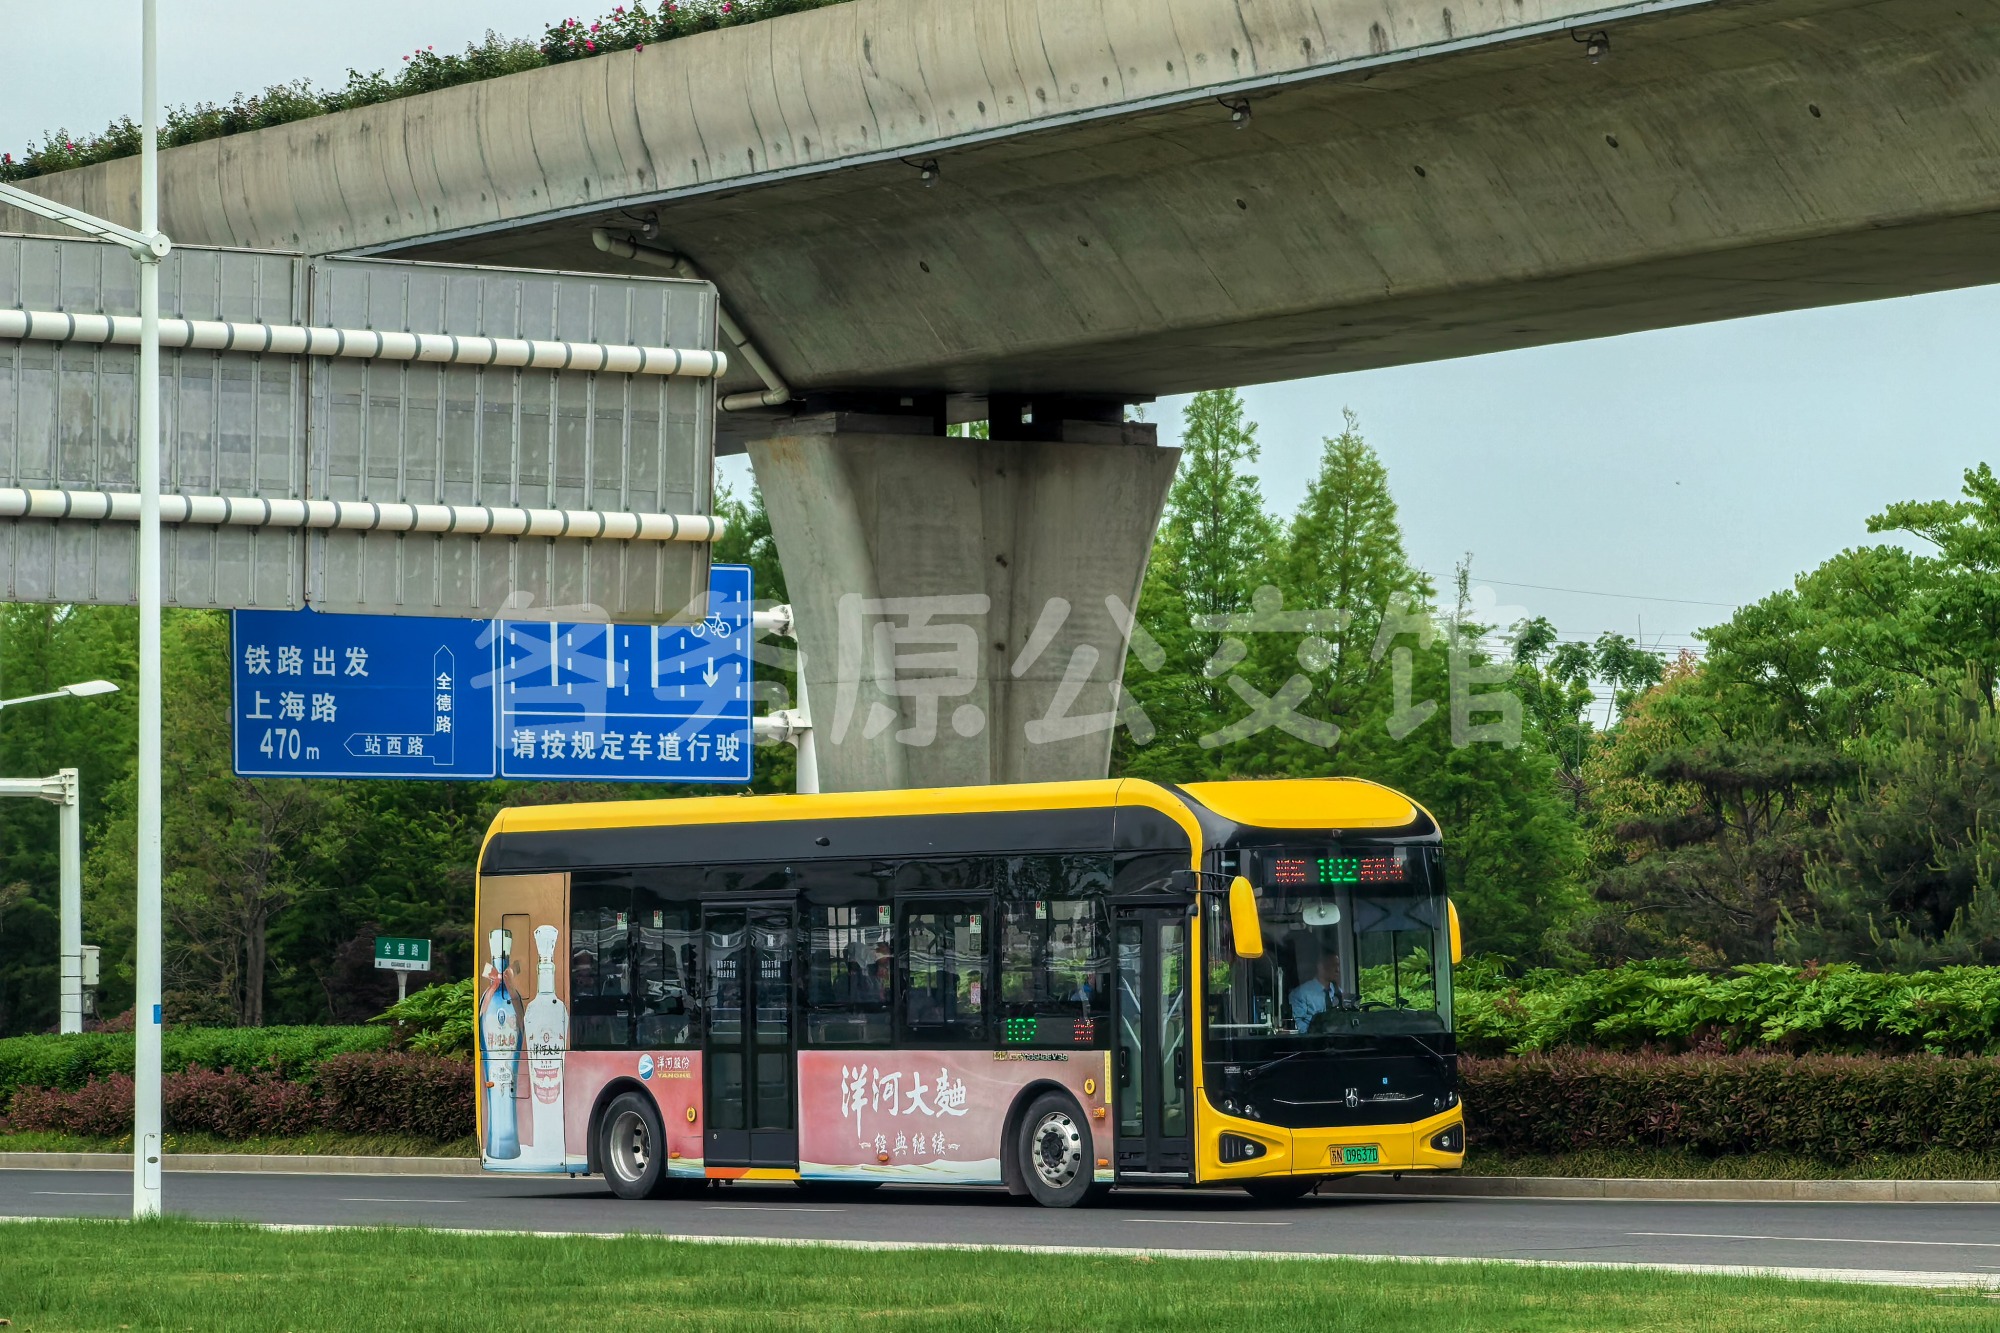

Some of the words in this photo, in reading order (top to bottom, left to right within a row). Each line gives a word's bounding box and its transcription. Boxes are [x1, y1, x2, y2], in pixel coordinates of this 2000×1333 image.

[245, 644, 370, 678] 铁路出发
[245, 690, 339, 722] 上海路
[436, 672, 453, 733] 全德路
[364, 734, 425, 756] 站西路
[511, 729, 741, 762] 请按规定车道行驶
[1317, 858, 1357, 882] 102
[384, 942, 419, 957] 全德路
